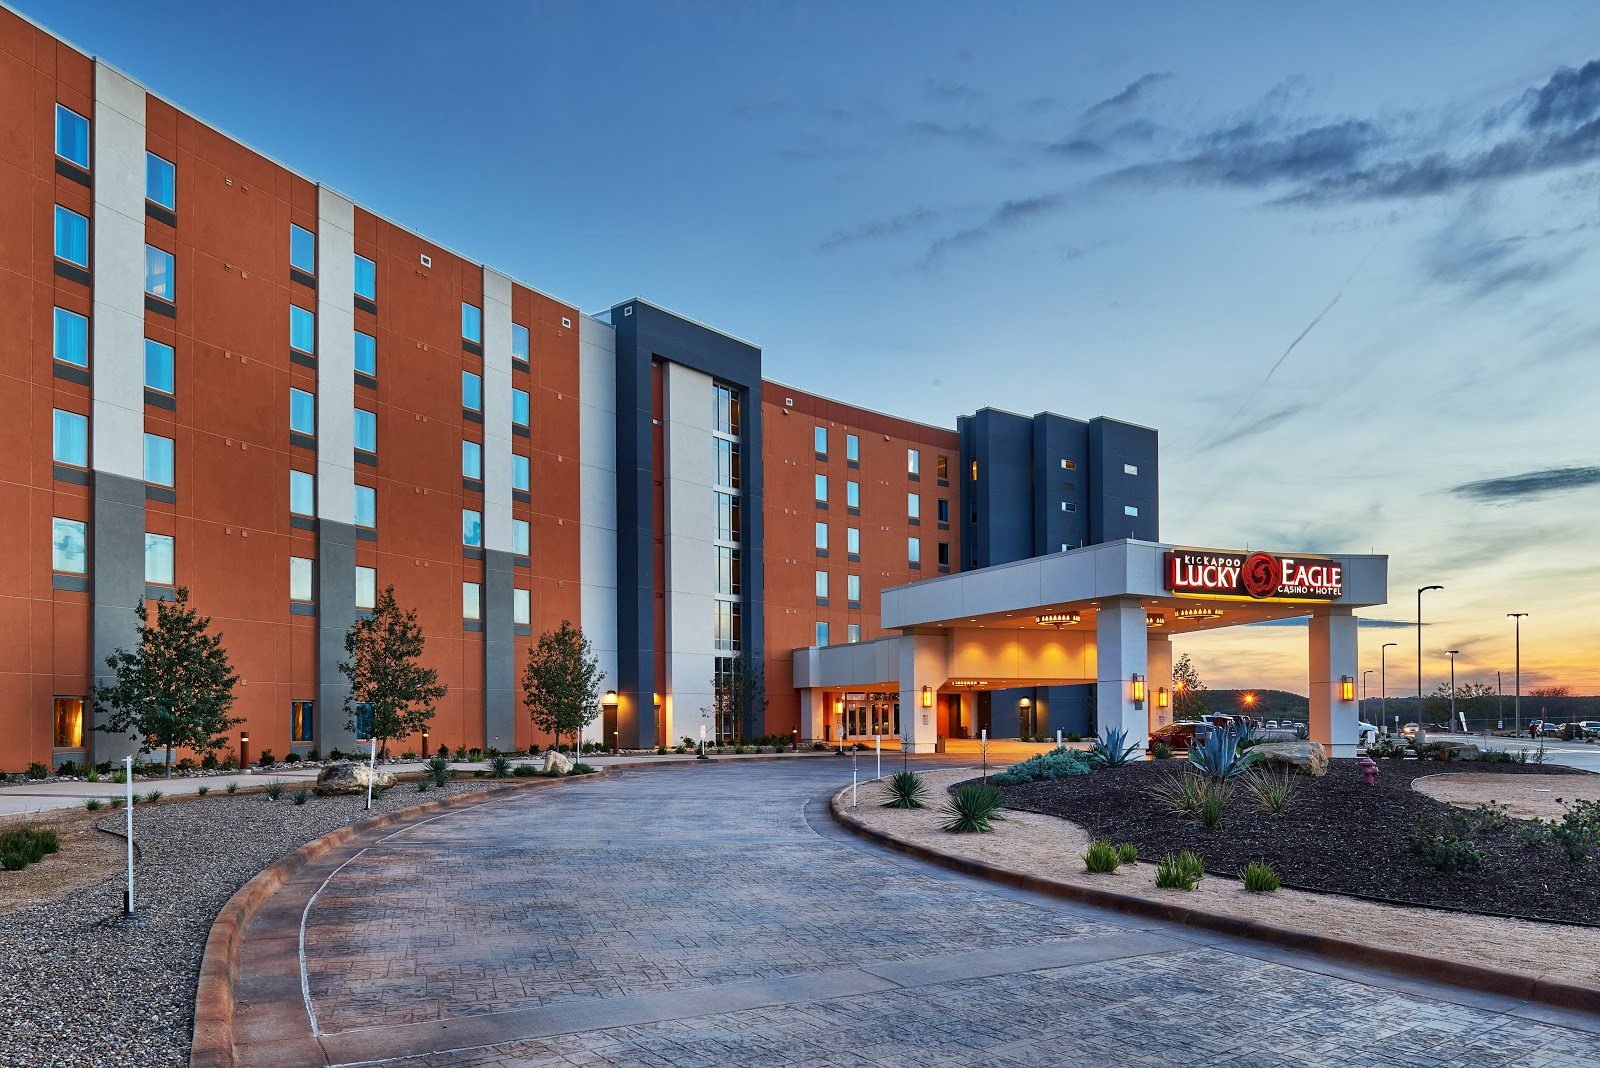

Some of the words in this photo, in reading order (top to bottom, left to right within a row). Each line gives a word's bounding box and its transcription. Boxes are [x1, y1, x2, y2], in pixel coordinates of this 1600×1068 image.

[1184, 555, 1241, 567] KICKAPOO
[1174, 558, 1241, 588] LUCKY
[1281, 559, 1342, 588] EAGLE
[1277, 585, 1308, 594] CASINO
[1315, 586, 1342, 596] HOTEL
